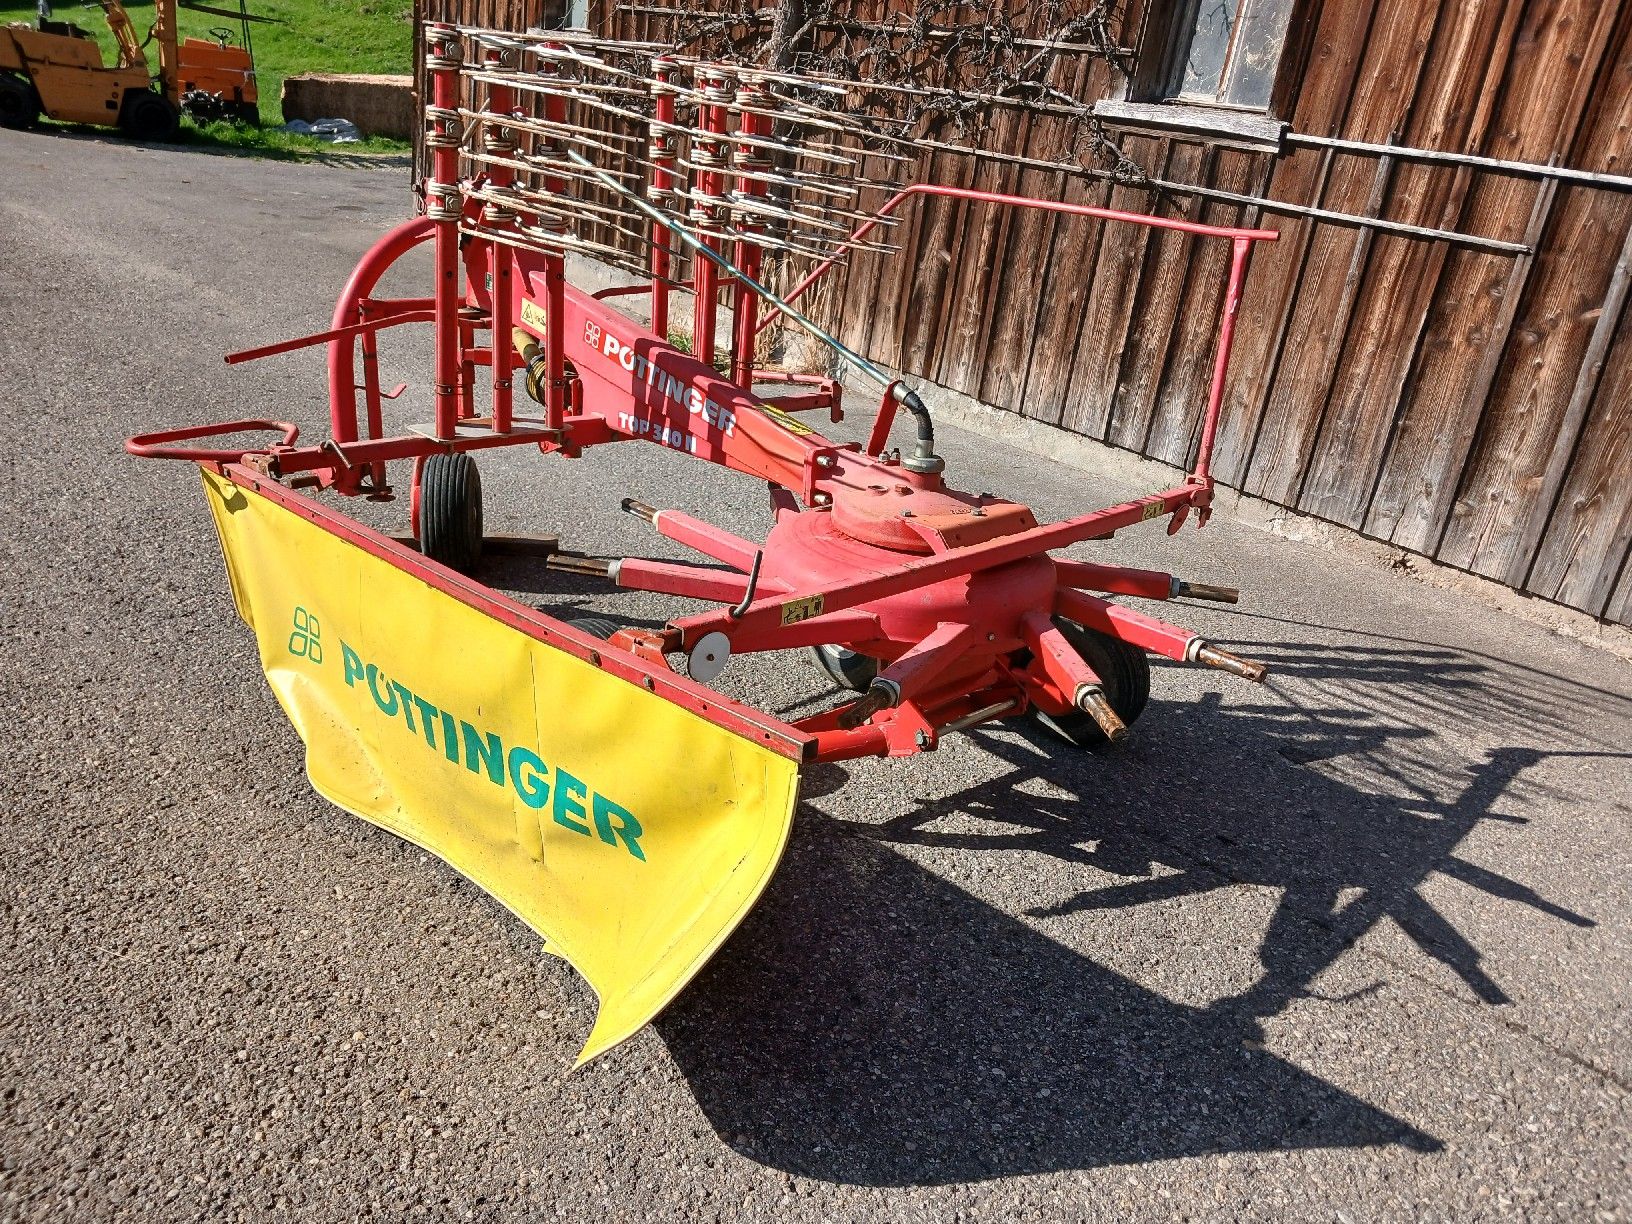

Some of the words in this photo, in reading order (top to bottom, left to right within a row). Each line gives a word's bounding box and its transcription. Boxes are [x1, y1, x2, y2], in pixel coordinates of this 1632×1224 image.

[617, 411, 650, 434] TOP
[652, 424, 682, 447] 340
[685, 435, 697, 454] N
